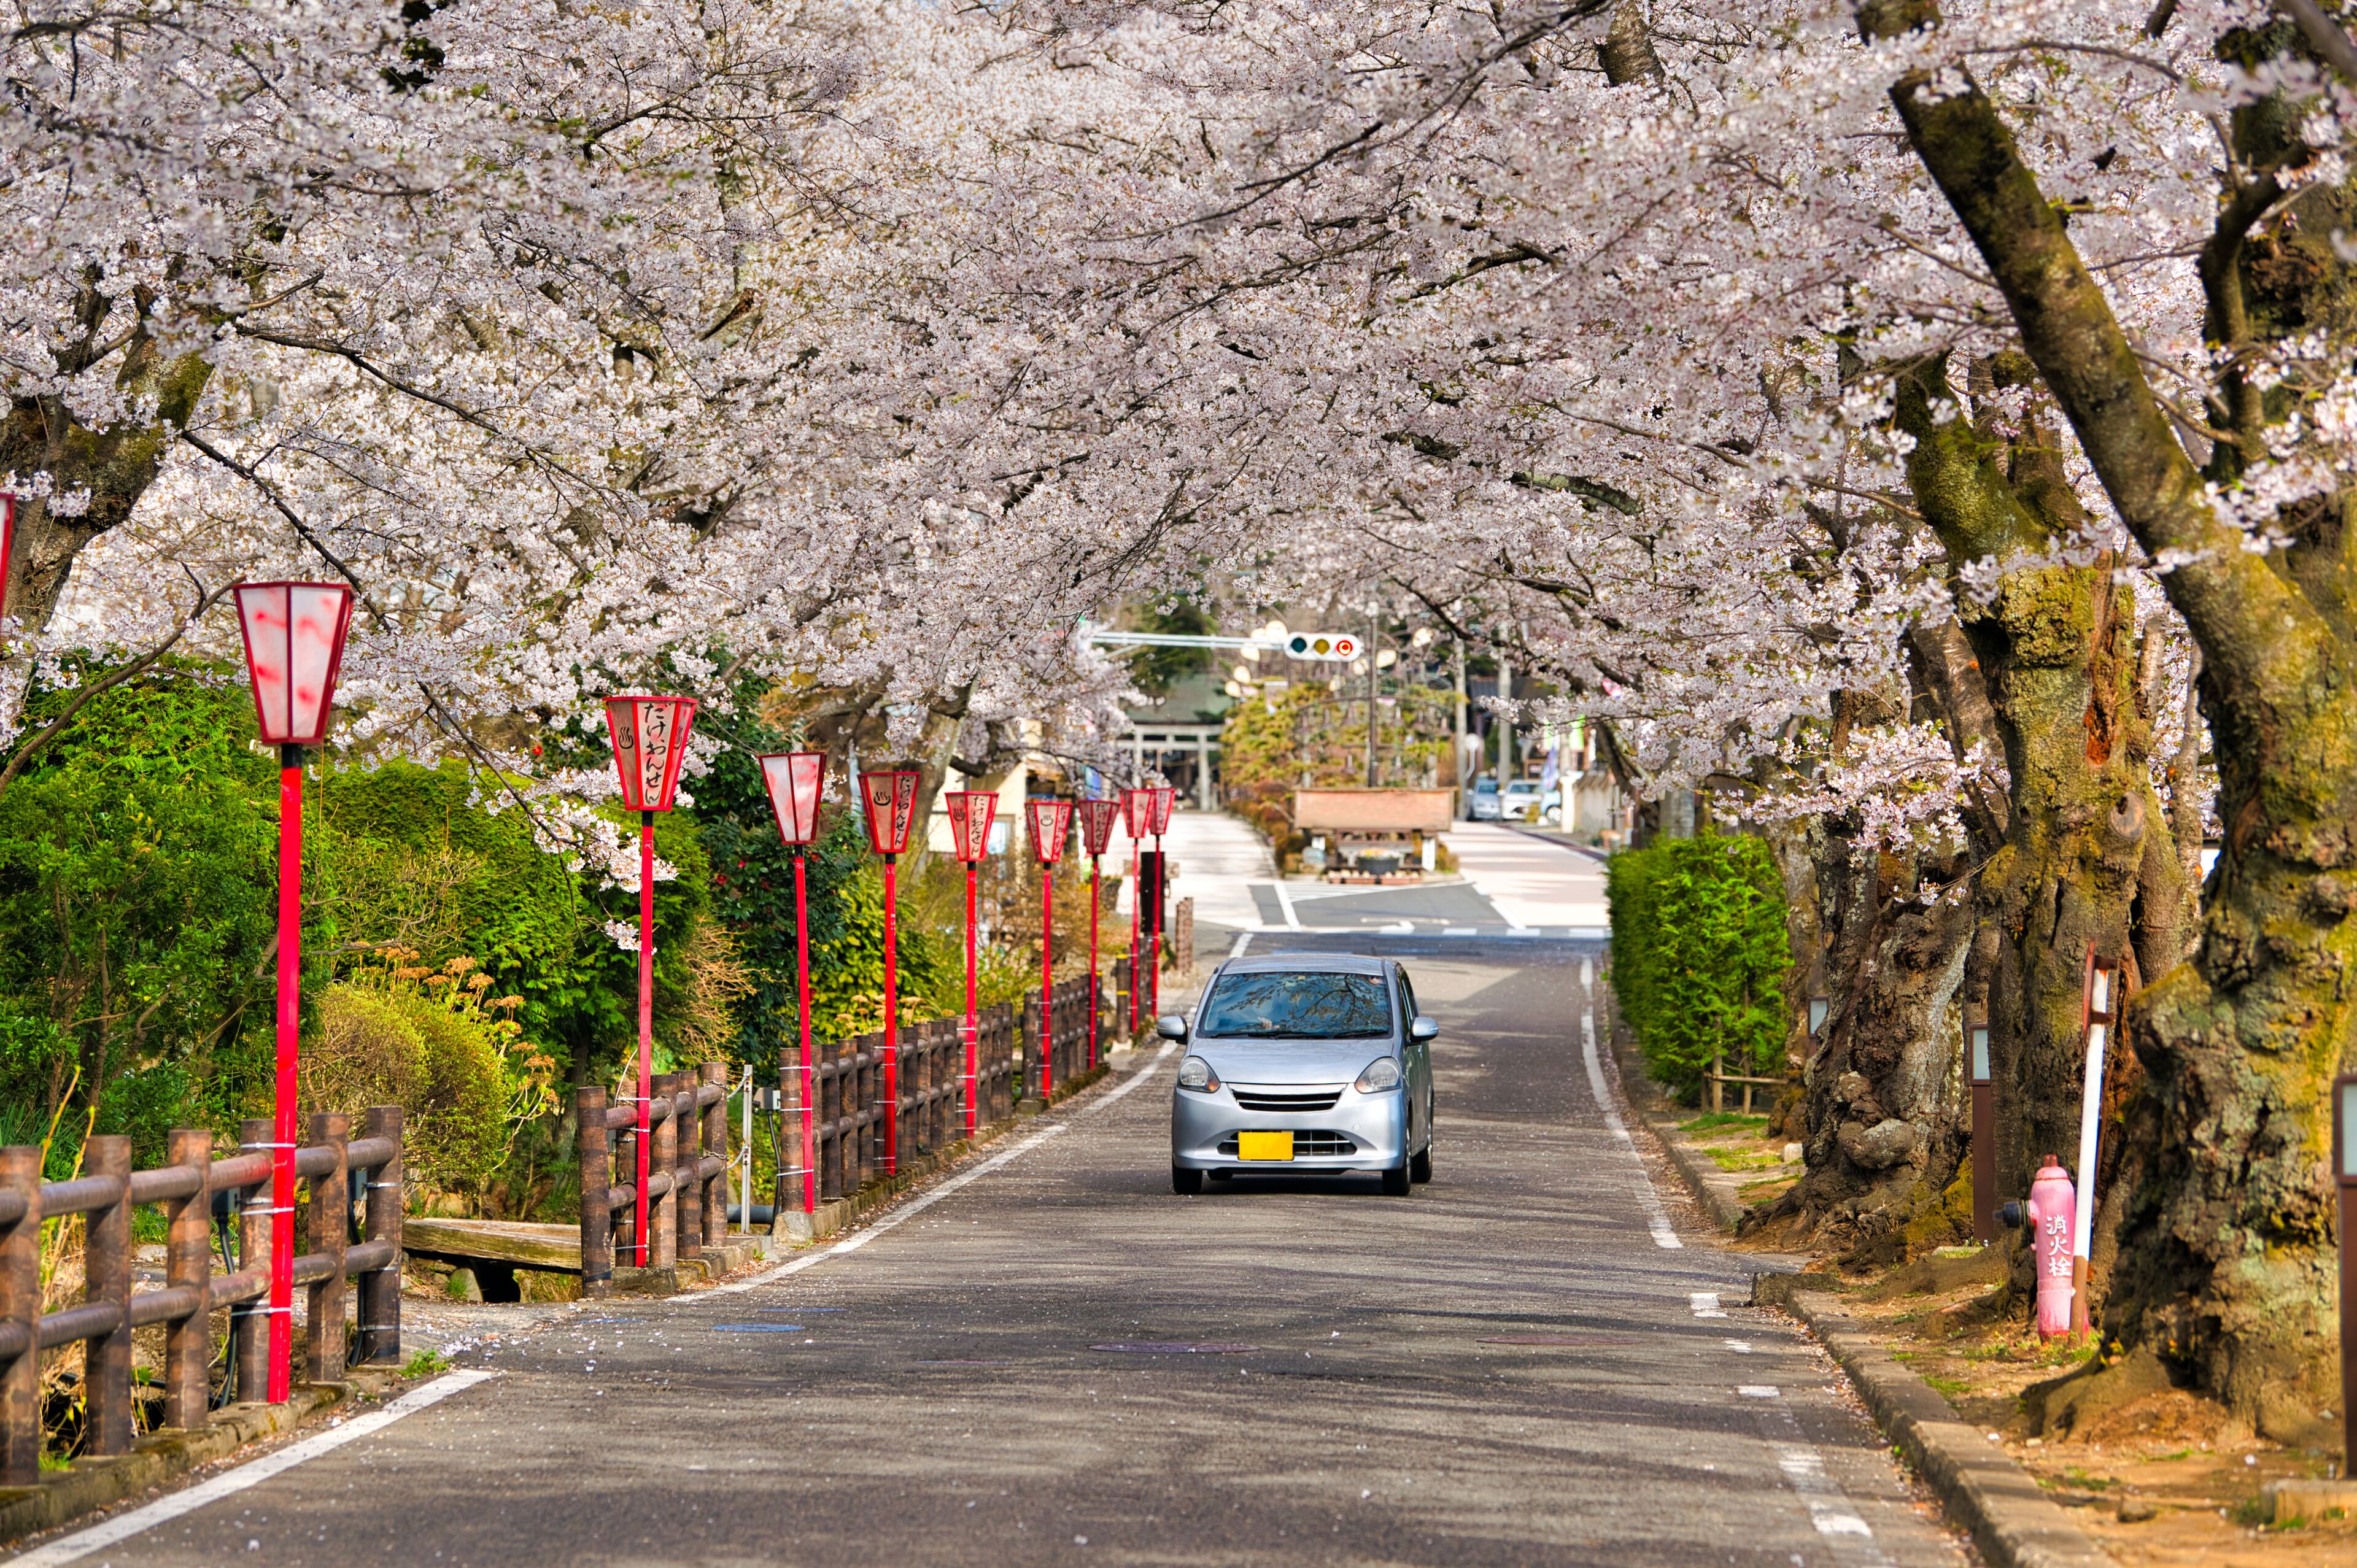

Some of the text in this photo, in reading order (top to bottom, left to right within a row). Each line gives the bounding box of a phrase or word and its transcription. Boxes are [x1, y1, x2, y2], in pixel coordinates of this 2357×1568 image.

[644, 703, 671, 805] だけおんせん
[2046, 1216, 2072, 1277] 消火栓
